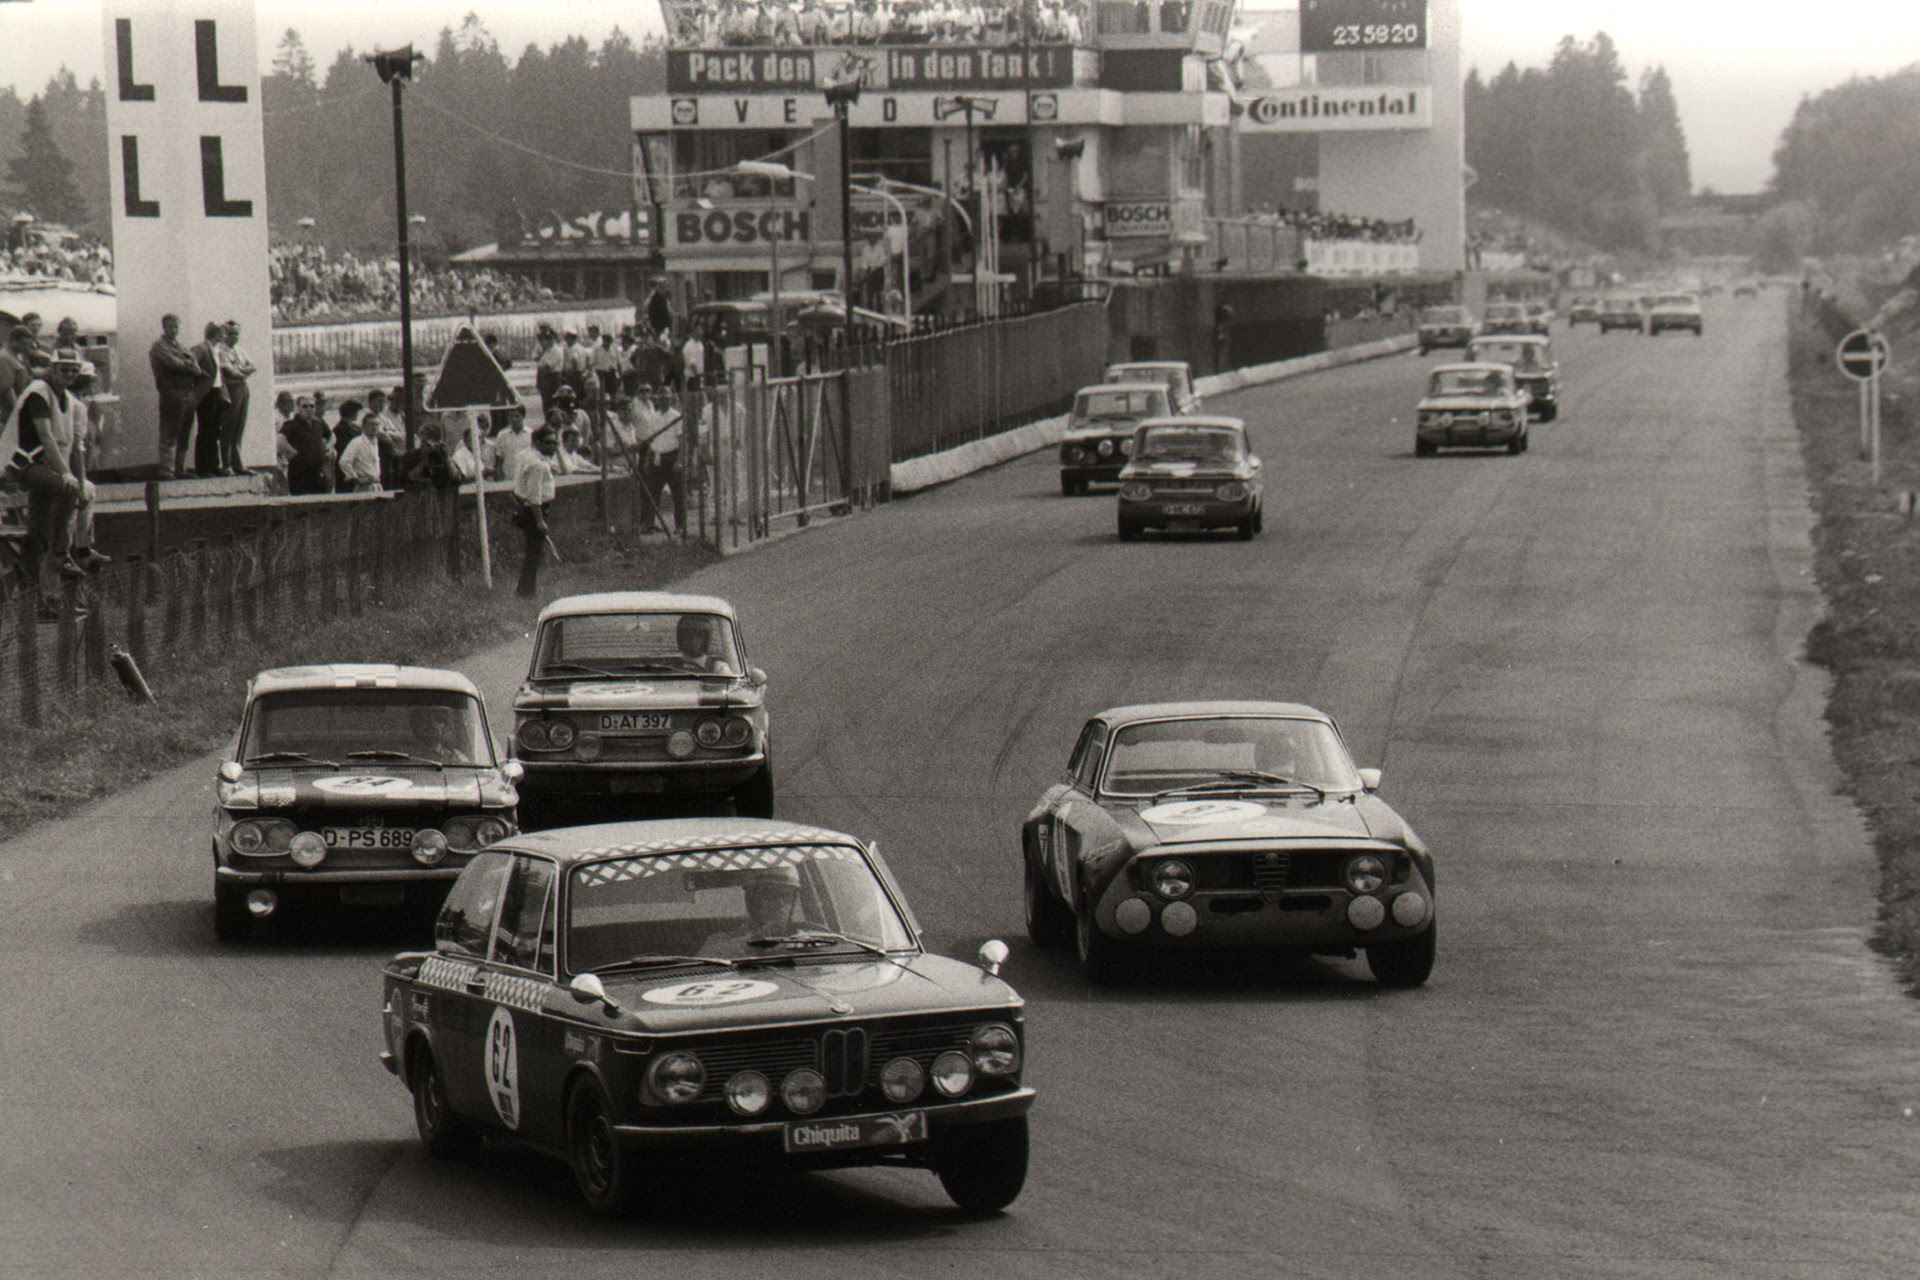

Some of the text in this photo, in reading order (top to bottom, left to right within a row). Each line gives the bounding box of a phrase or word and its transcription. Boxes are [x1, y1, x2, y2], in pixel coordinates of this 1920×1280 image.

[689, 52, 755, 82] Pack
[763, 52, 811, 82] den
[924, 50, 972, 80] den
[977, 49, 1041, 80] Tank
[1247, 92, 1417, 125] Continental
[497, 209, 657, 246] OSCH
[676, 210, 810, 243] BOSCH
[1107, 206, 1169, 222] BOSCH
[675, 982, 754, 996] 62
[492, 1020, 512, 1089] 62
[794, 1123, 860, 1147] Chiquita
